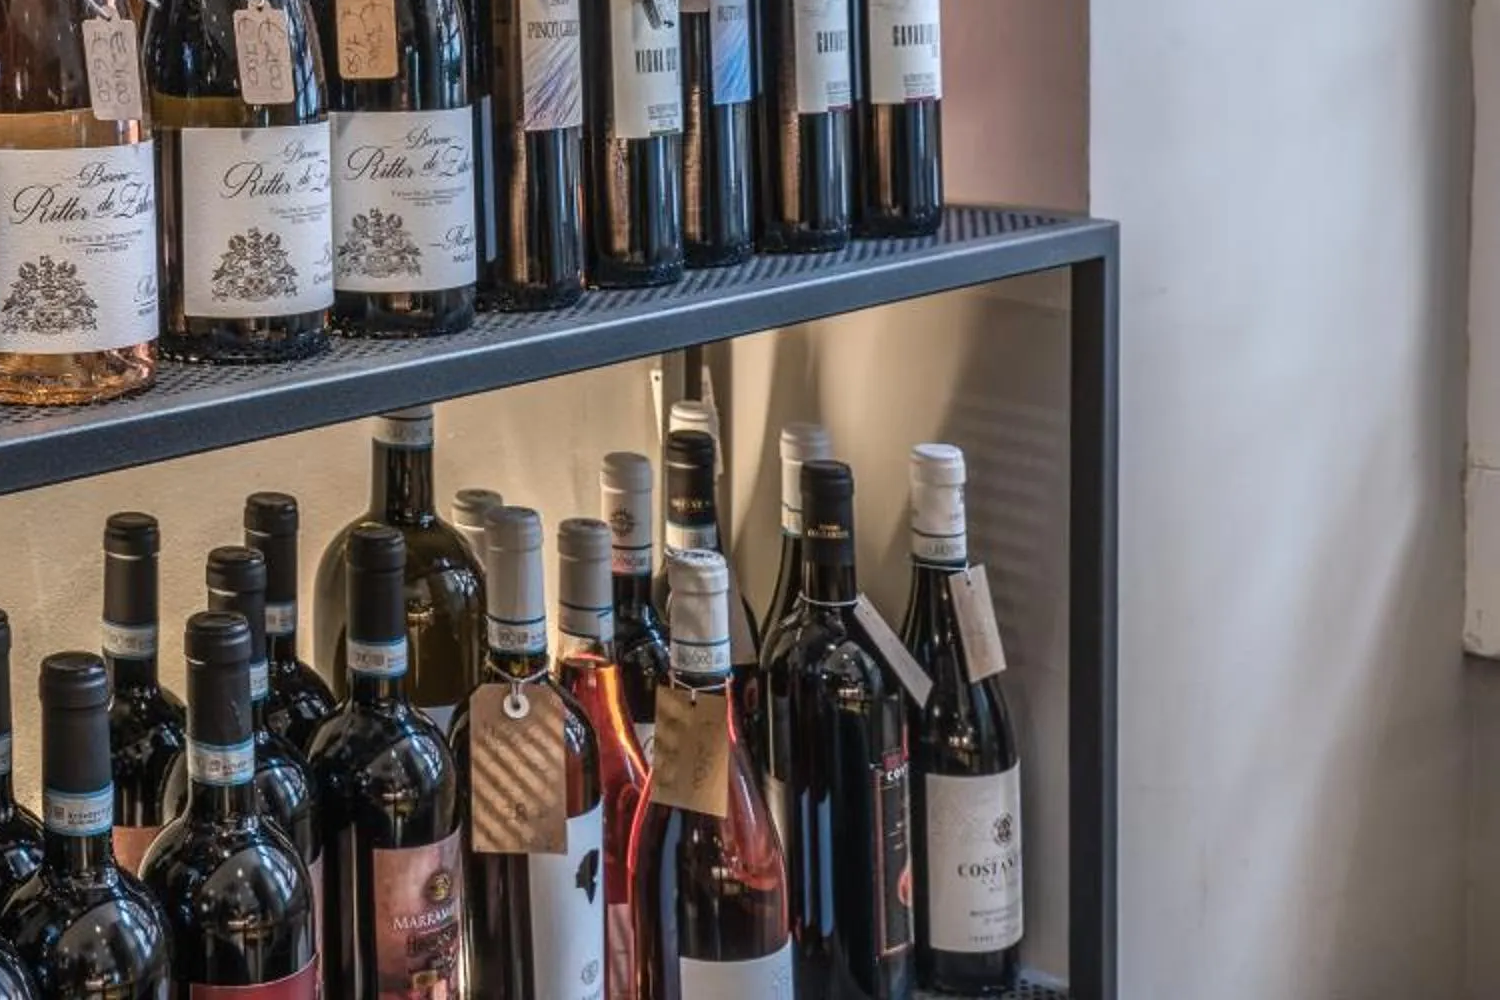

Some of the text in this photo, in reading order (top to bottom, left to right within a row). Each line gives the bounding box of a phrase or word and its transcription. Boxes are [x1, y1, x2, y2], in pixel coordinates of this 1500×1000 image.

[220, 161, 291, 198] Ritter
[344, 145, 414, 180] Ritter
[10, 184, 88, 224] Ritter
